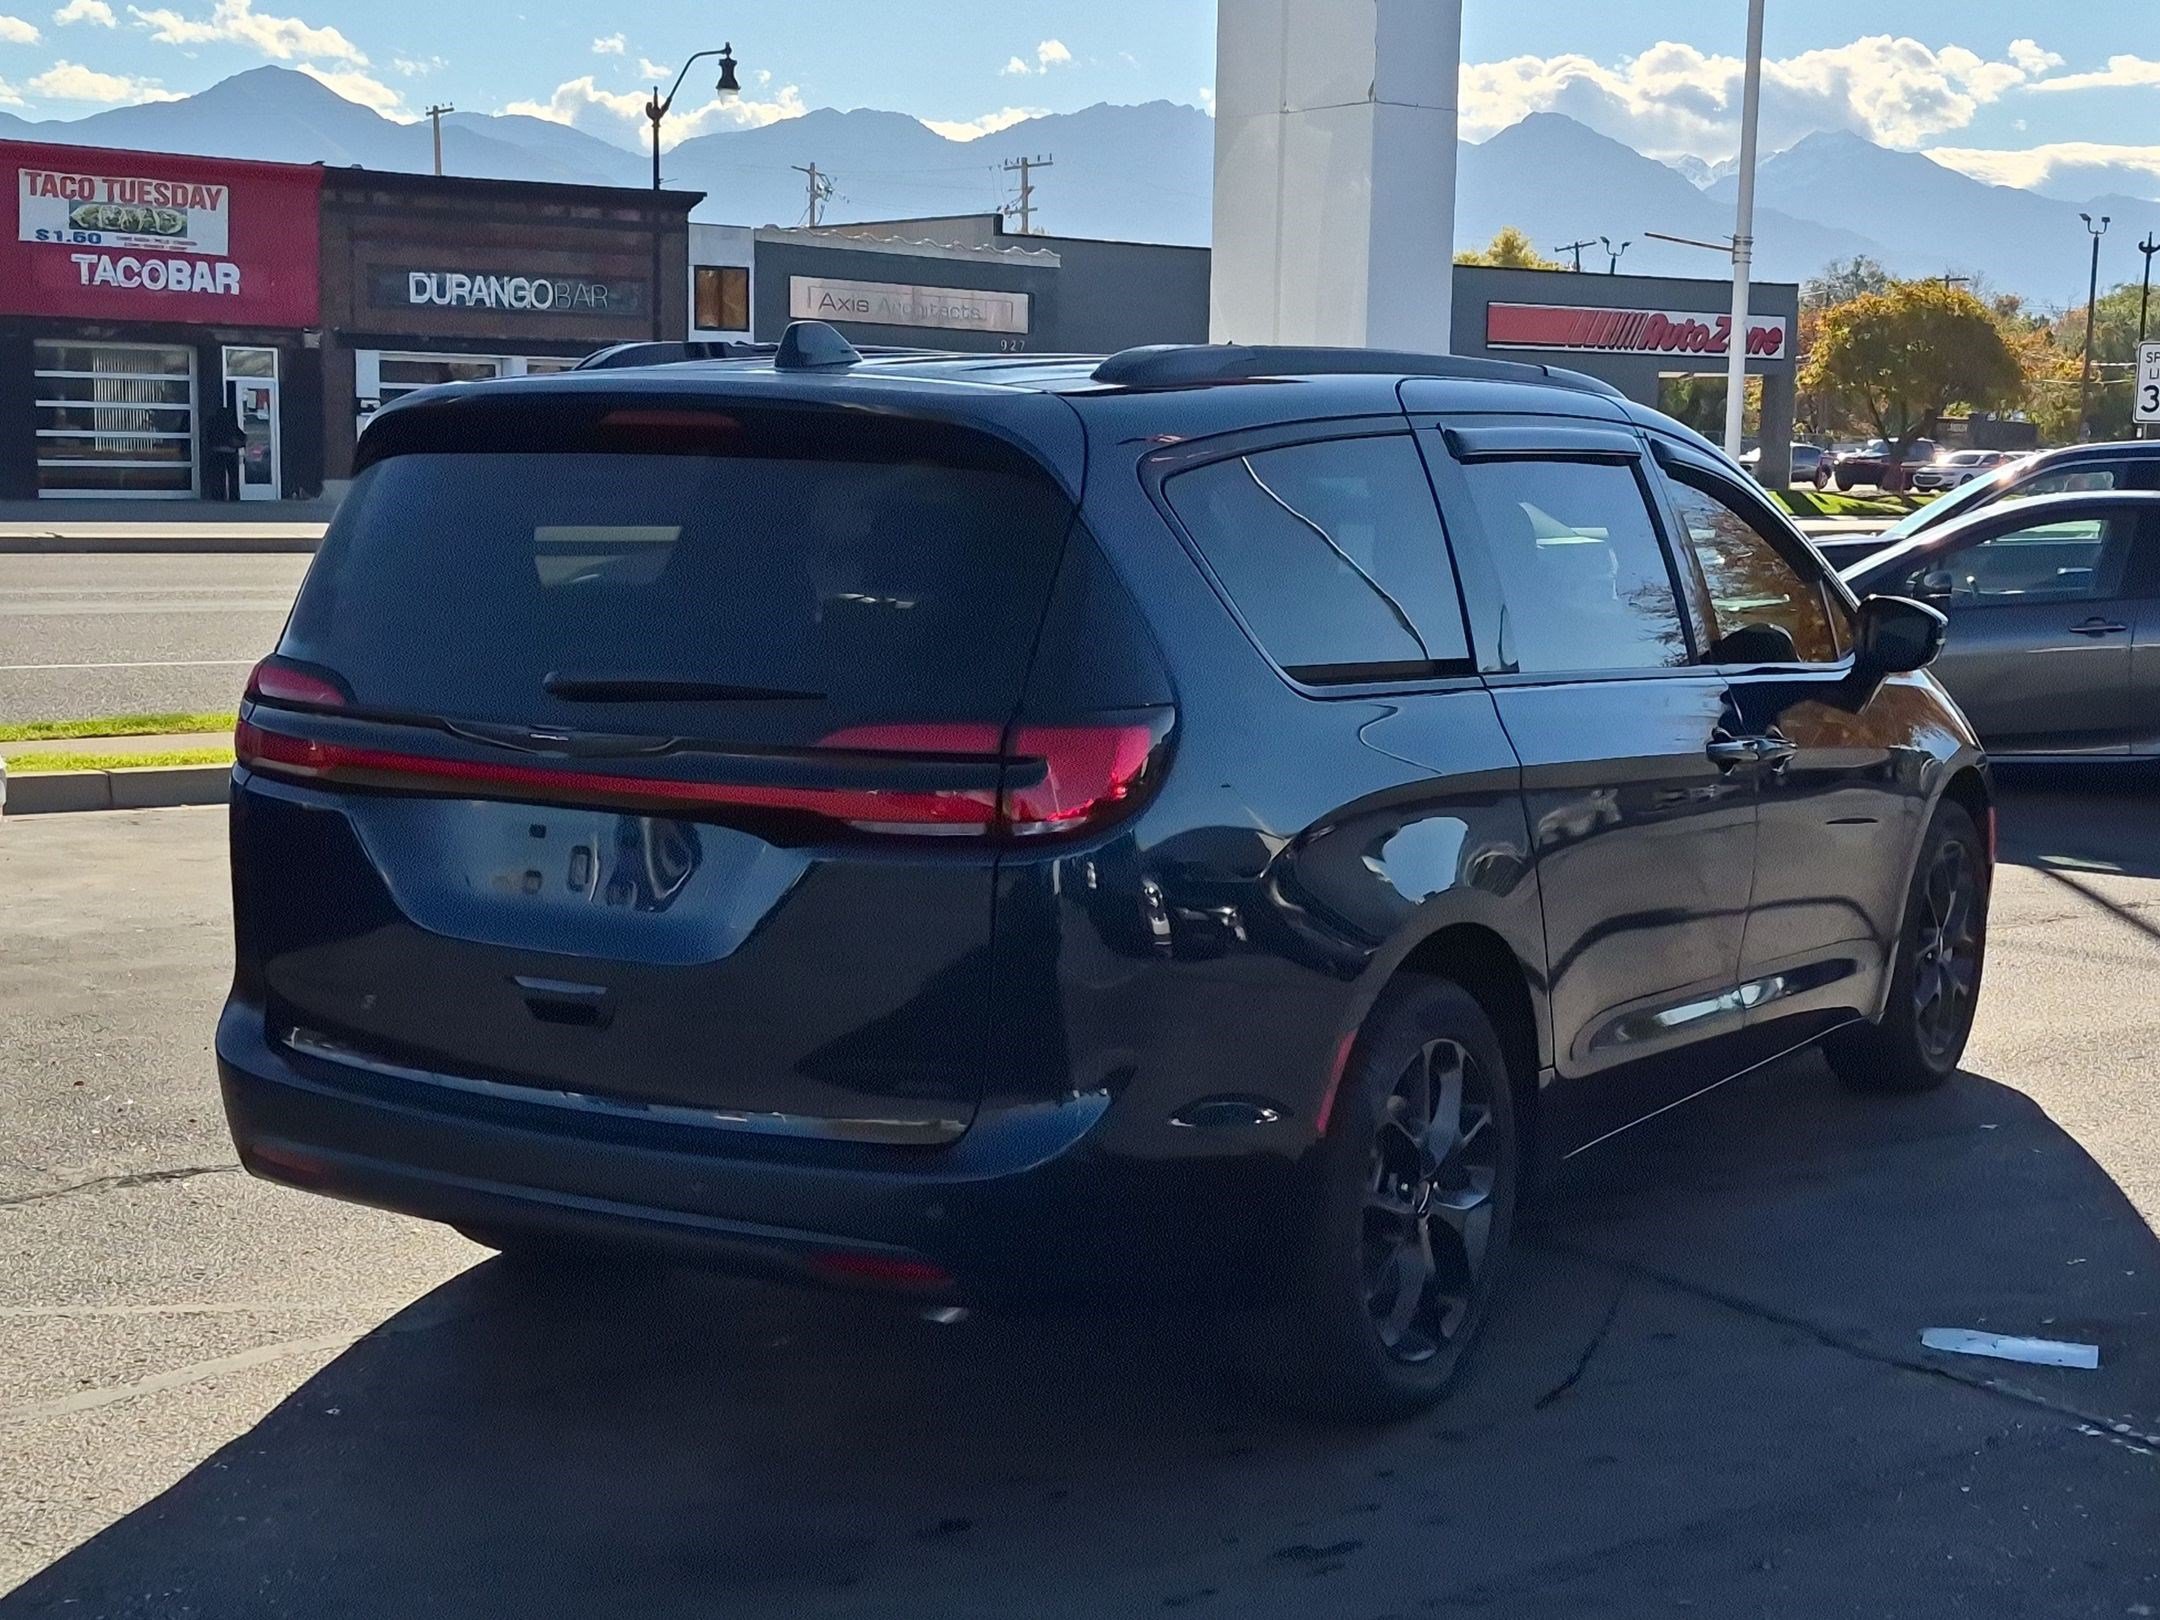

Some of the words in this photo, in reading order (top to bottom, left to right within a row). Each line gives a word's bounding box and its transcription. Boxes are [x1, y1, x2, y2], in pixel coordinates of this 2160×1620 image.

[24, 170, 96, 202] TACO
[102, 178, 223, 211] TUESDAY
[71, 253, 241, 295] TACOBAR
[817, 292, 870, 314] Axis
[1000, 339, 1025, 351] 927
[1637, 312, 1783, 356] AutoZne
